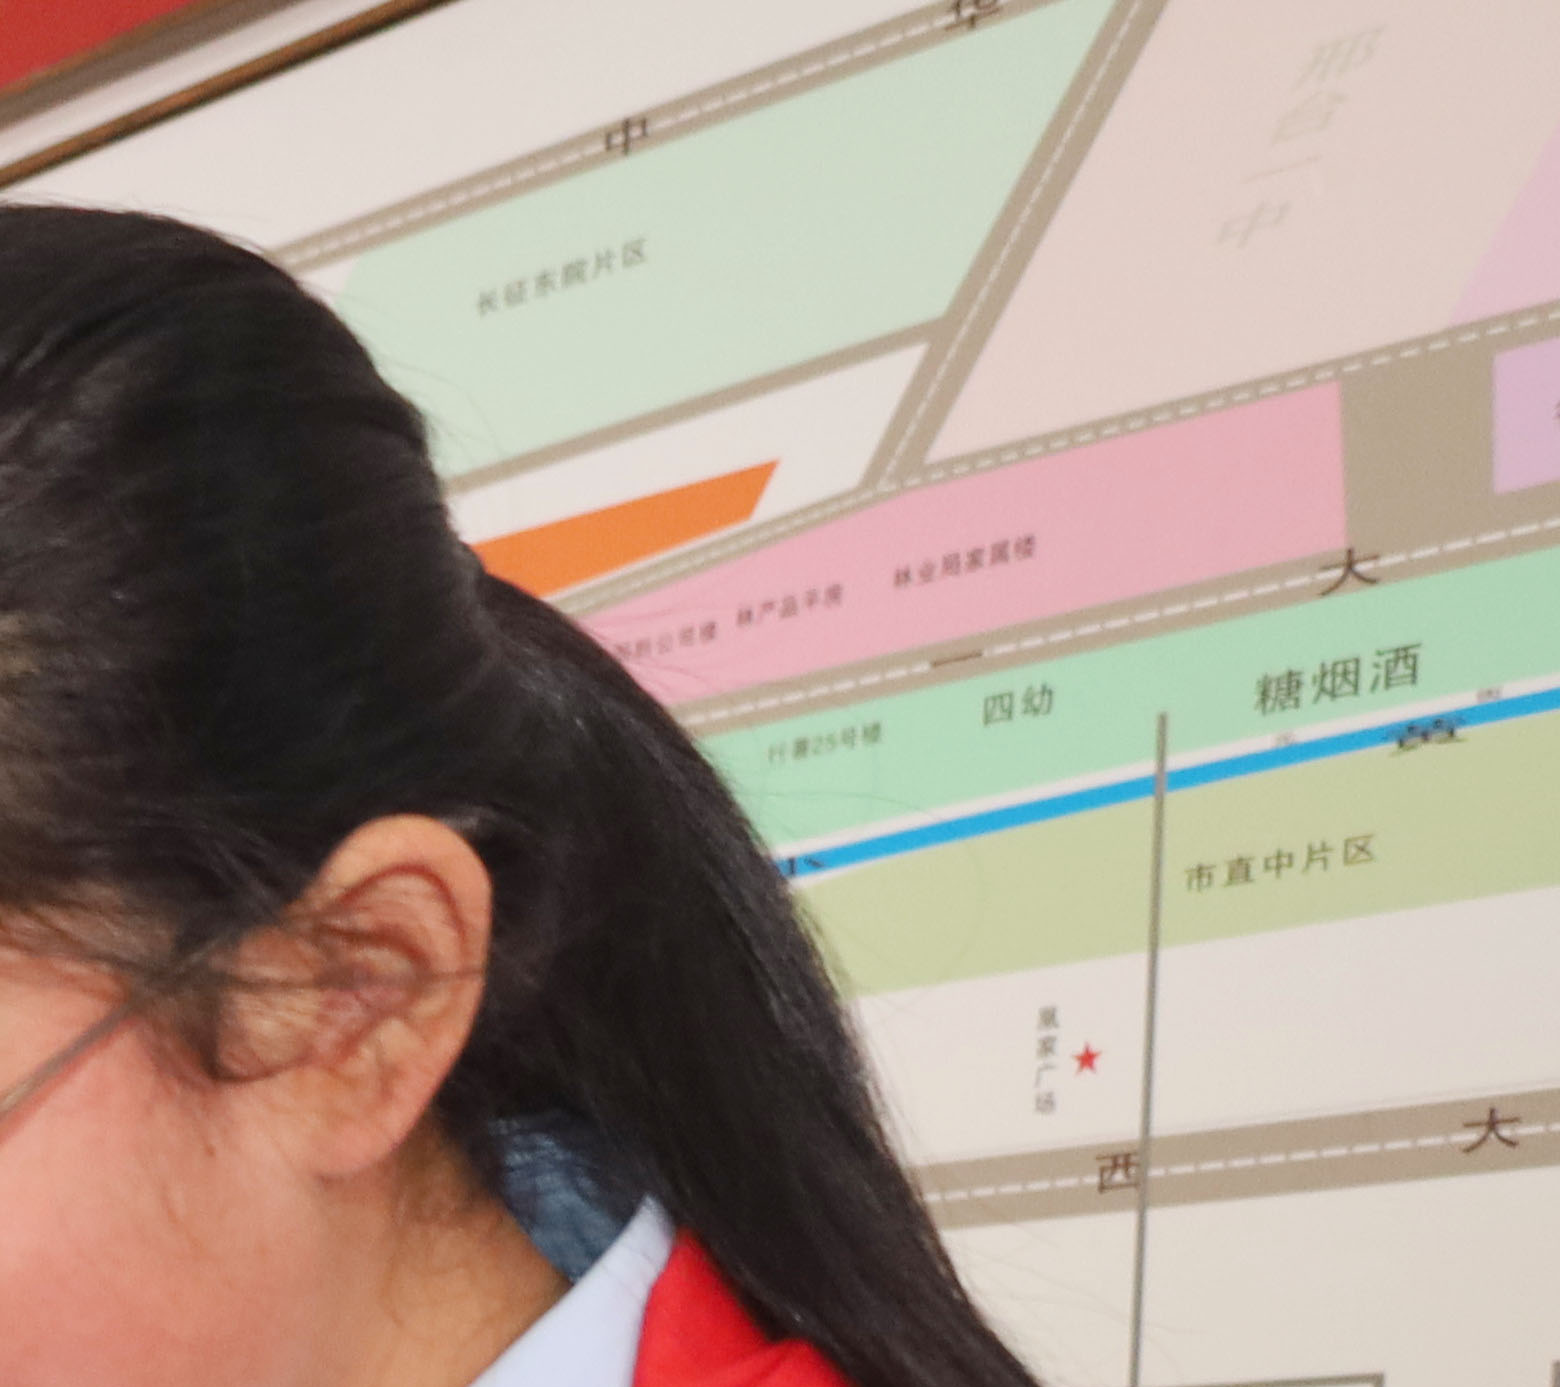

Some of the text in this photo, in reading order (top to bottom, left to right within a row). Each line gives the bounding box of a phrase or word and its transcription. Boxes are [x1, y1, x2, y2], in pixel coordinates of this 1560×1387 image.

[981, 682, 1056, 726] 四幼
[1255, 642, 1423, 716] 糖烟酒
[1183, 832, 1377, 894] 市直中片区
[1096, 1107, 1520, 1193] 西 大
